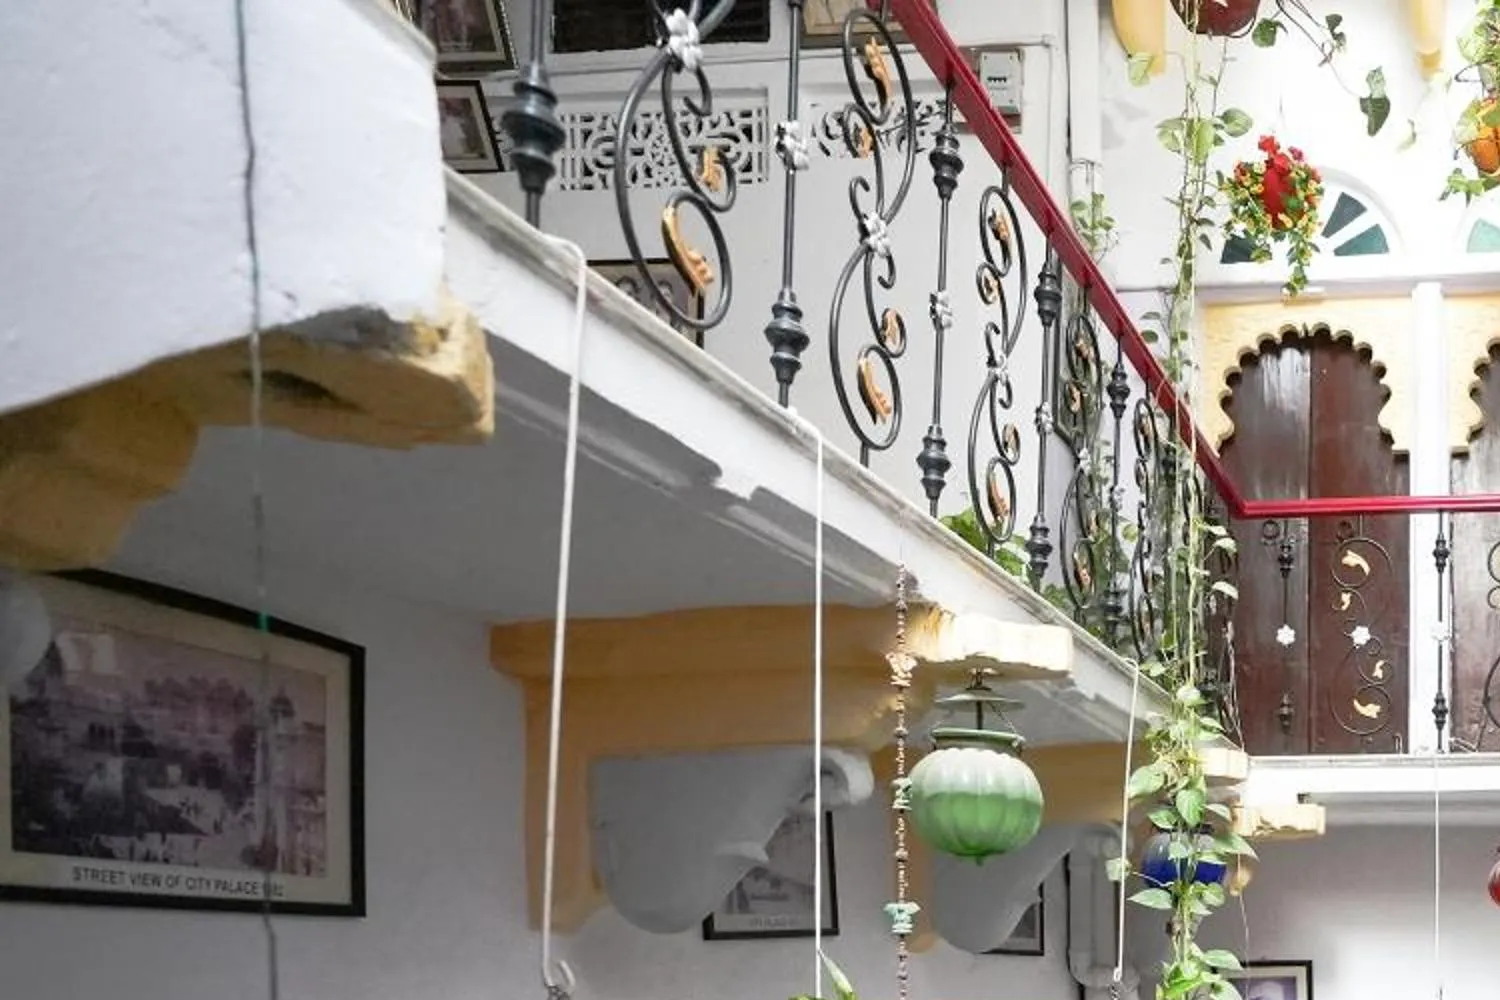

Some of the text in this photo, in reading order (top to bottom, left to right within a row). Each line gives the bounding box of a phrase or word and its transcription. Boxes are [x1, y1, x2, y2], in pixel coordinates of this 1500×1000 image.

[72, 866, 125, 885] STREET
[130, 872, 161, 888] VIEW
[165, 875, 180, 888] OF
[185, 877, 211, 891] CITY
[215, 879, 258, 895] PALACE
